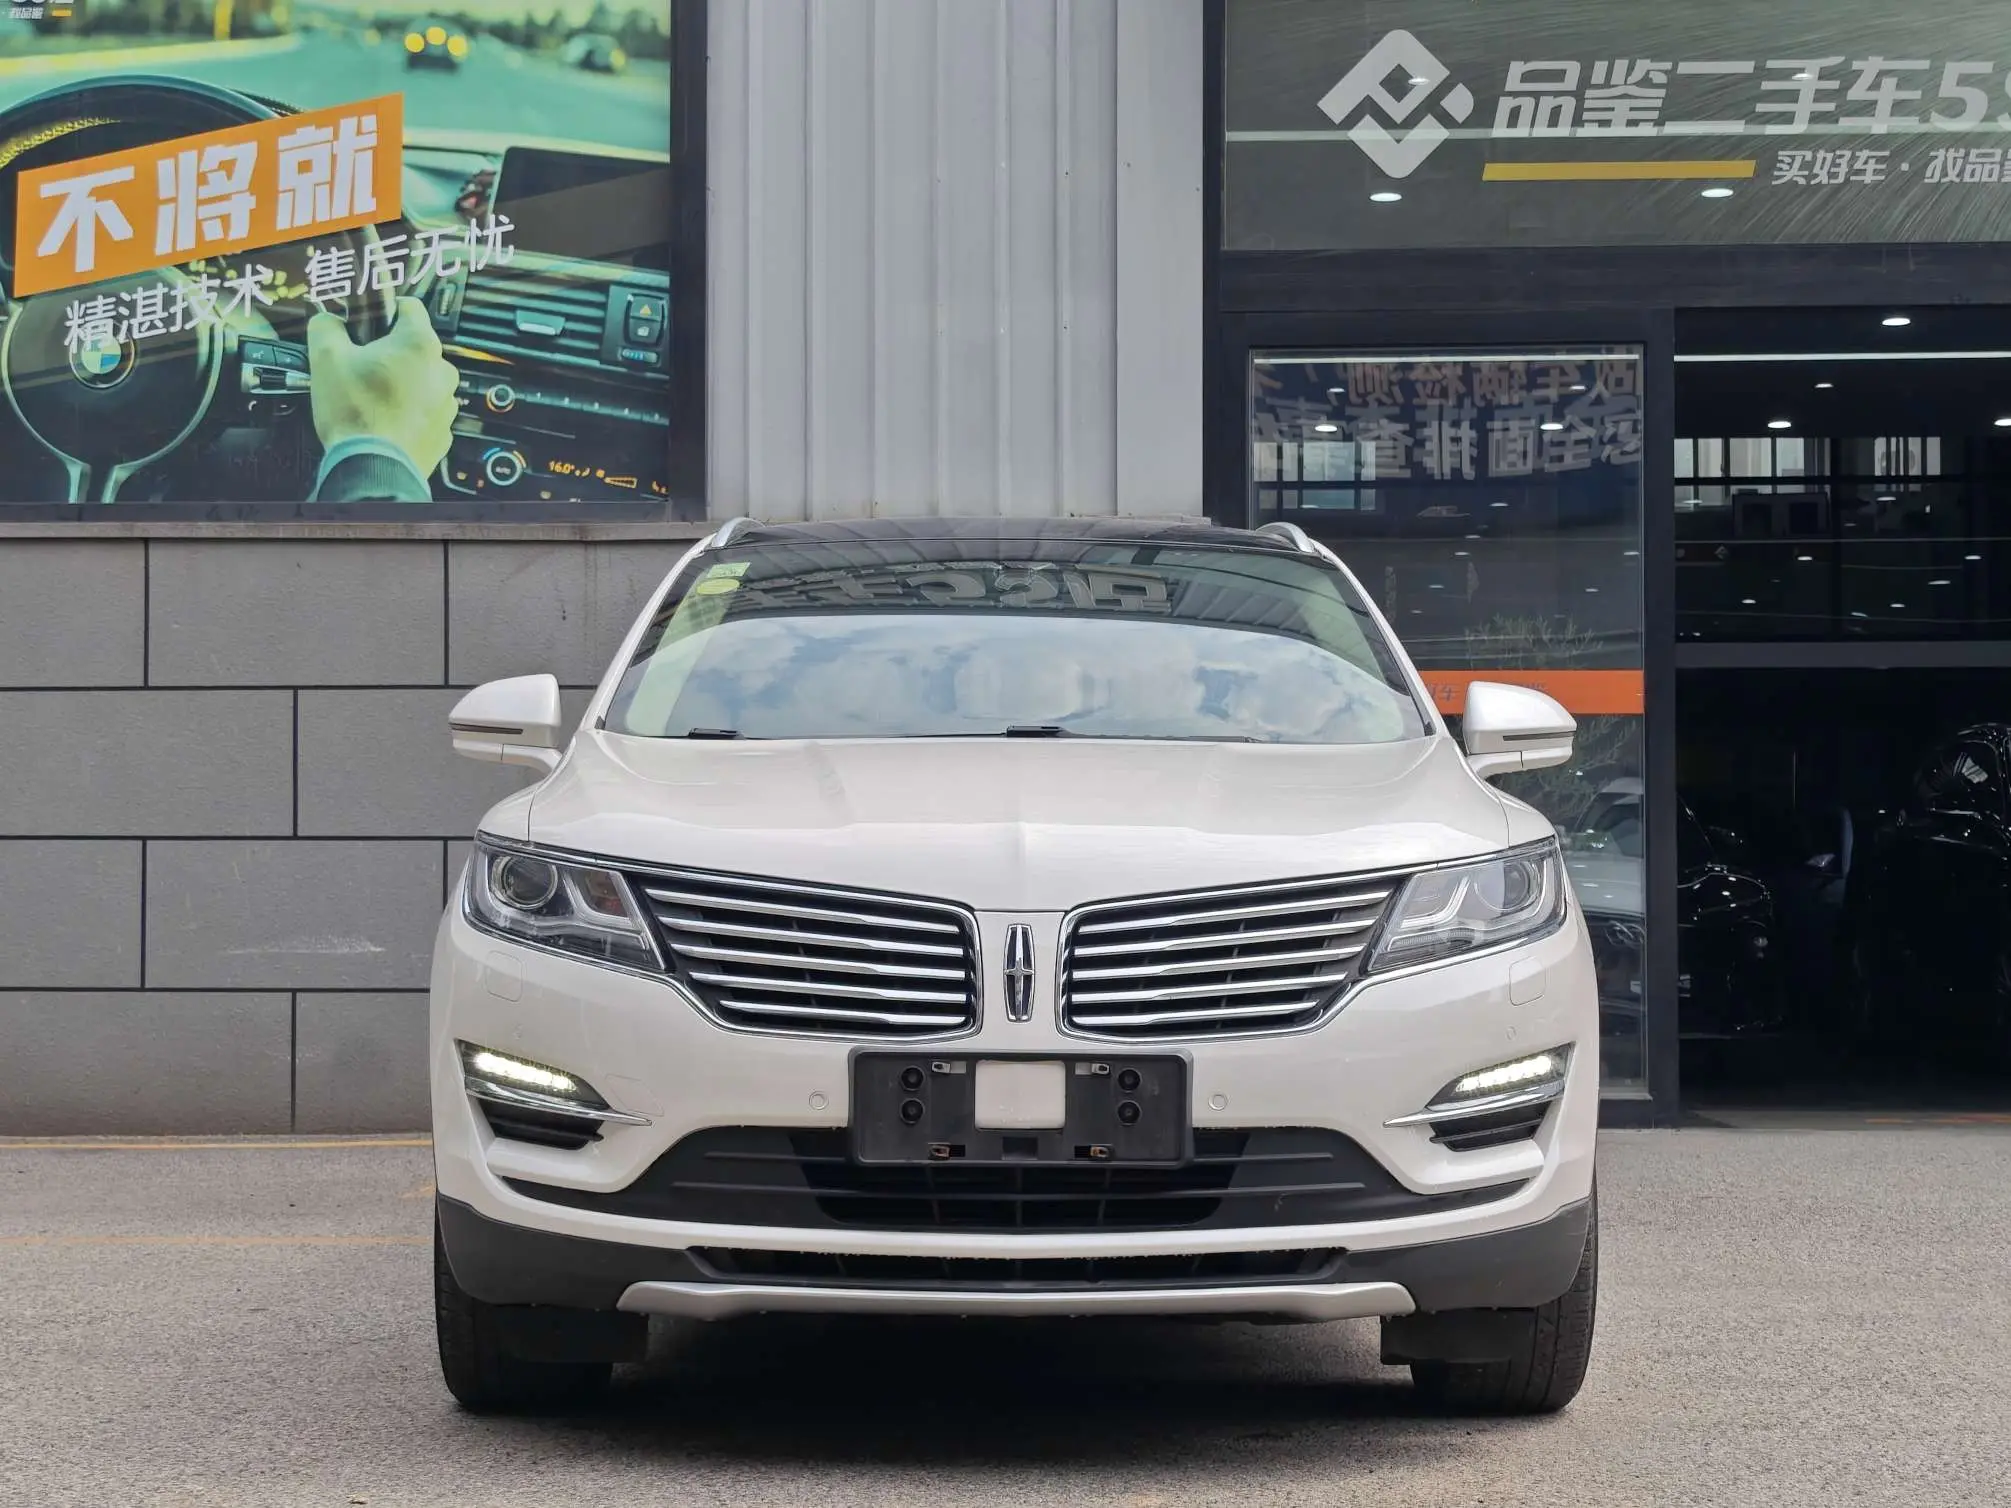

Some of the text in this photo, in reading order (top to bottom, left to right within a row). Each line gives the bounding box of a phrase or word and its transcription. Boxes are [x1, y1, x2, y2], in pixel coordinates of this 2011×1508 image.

[1491, 56, 2011, 137] 品鉴二手车5
[37, 114, 377, 272] 不将就
[304, 213, 515, 301] 售后无忧
[64, 264, 275, 353] 精湛技术
